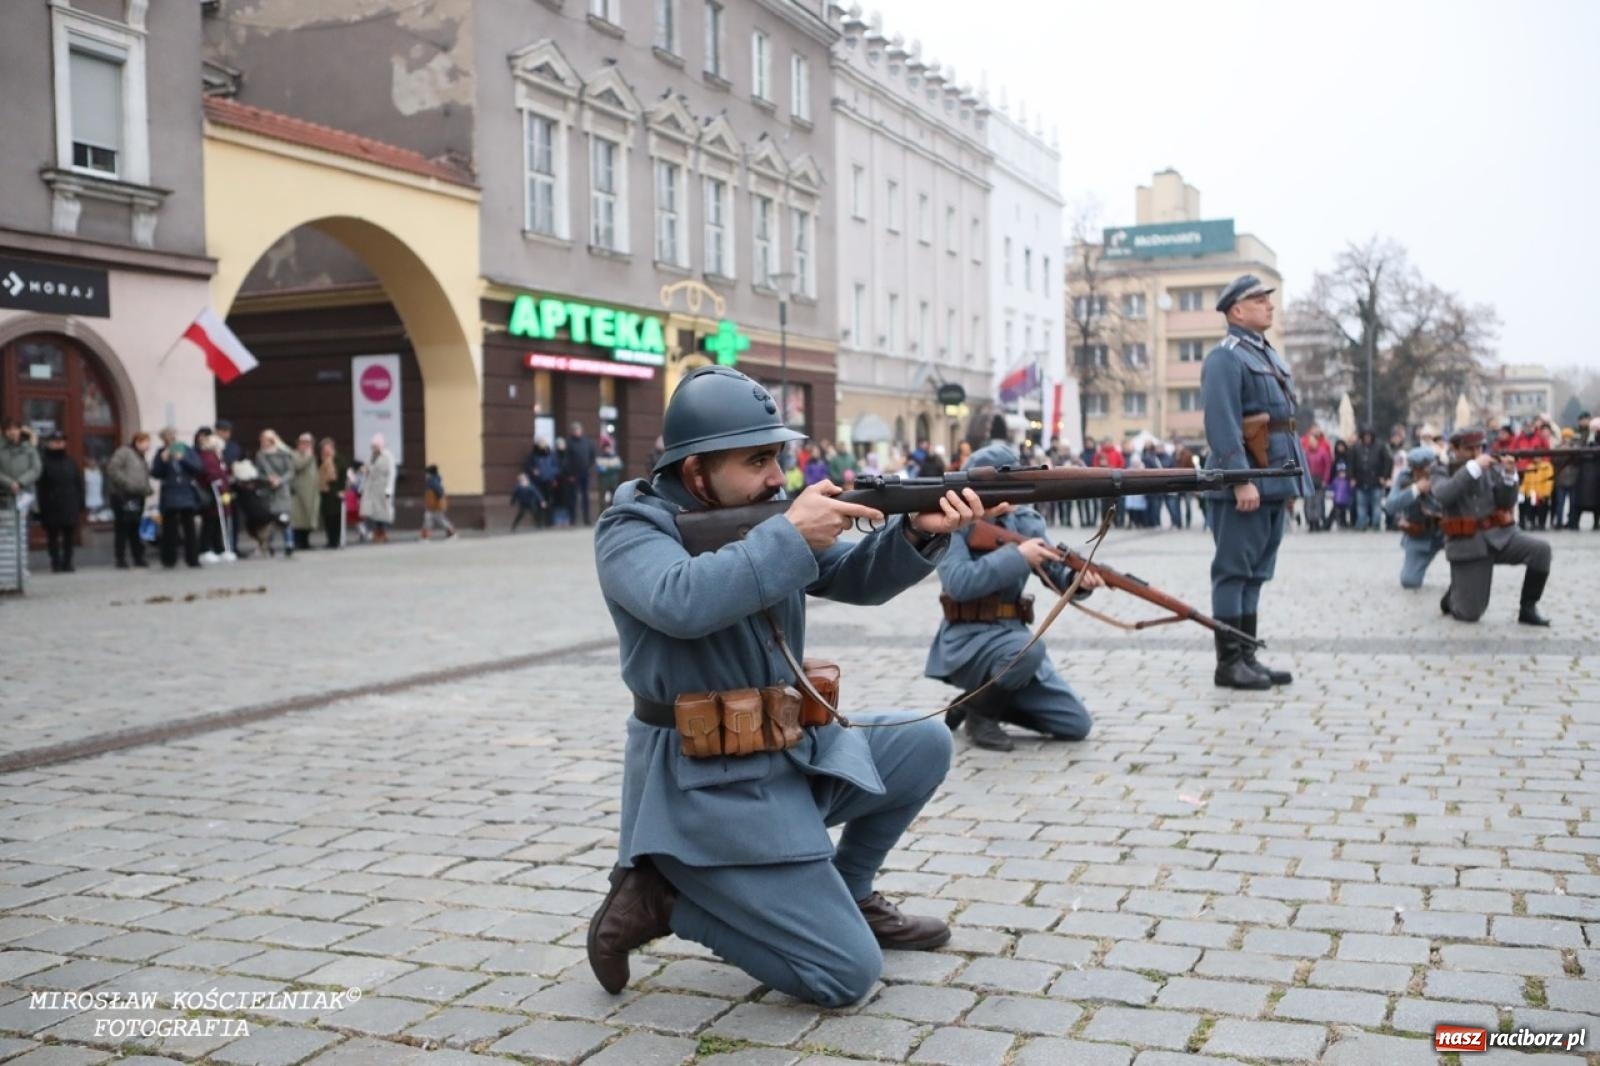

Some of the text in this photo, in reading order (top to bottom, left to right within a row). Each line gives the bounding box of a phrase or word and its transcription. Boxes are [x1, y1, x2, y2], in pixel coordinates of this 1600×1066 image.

[1134, 232, 1201, 248] McDonald's
[29, 280, 94, 299] MORAJ
[509, 295, 665, 353] APTEKA
